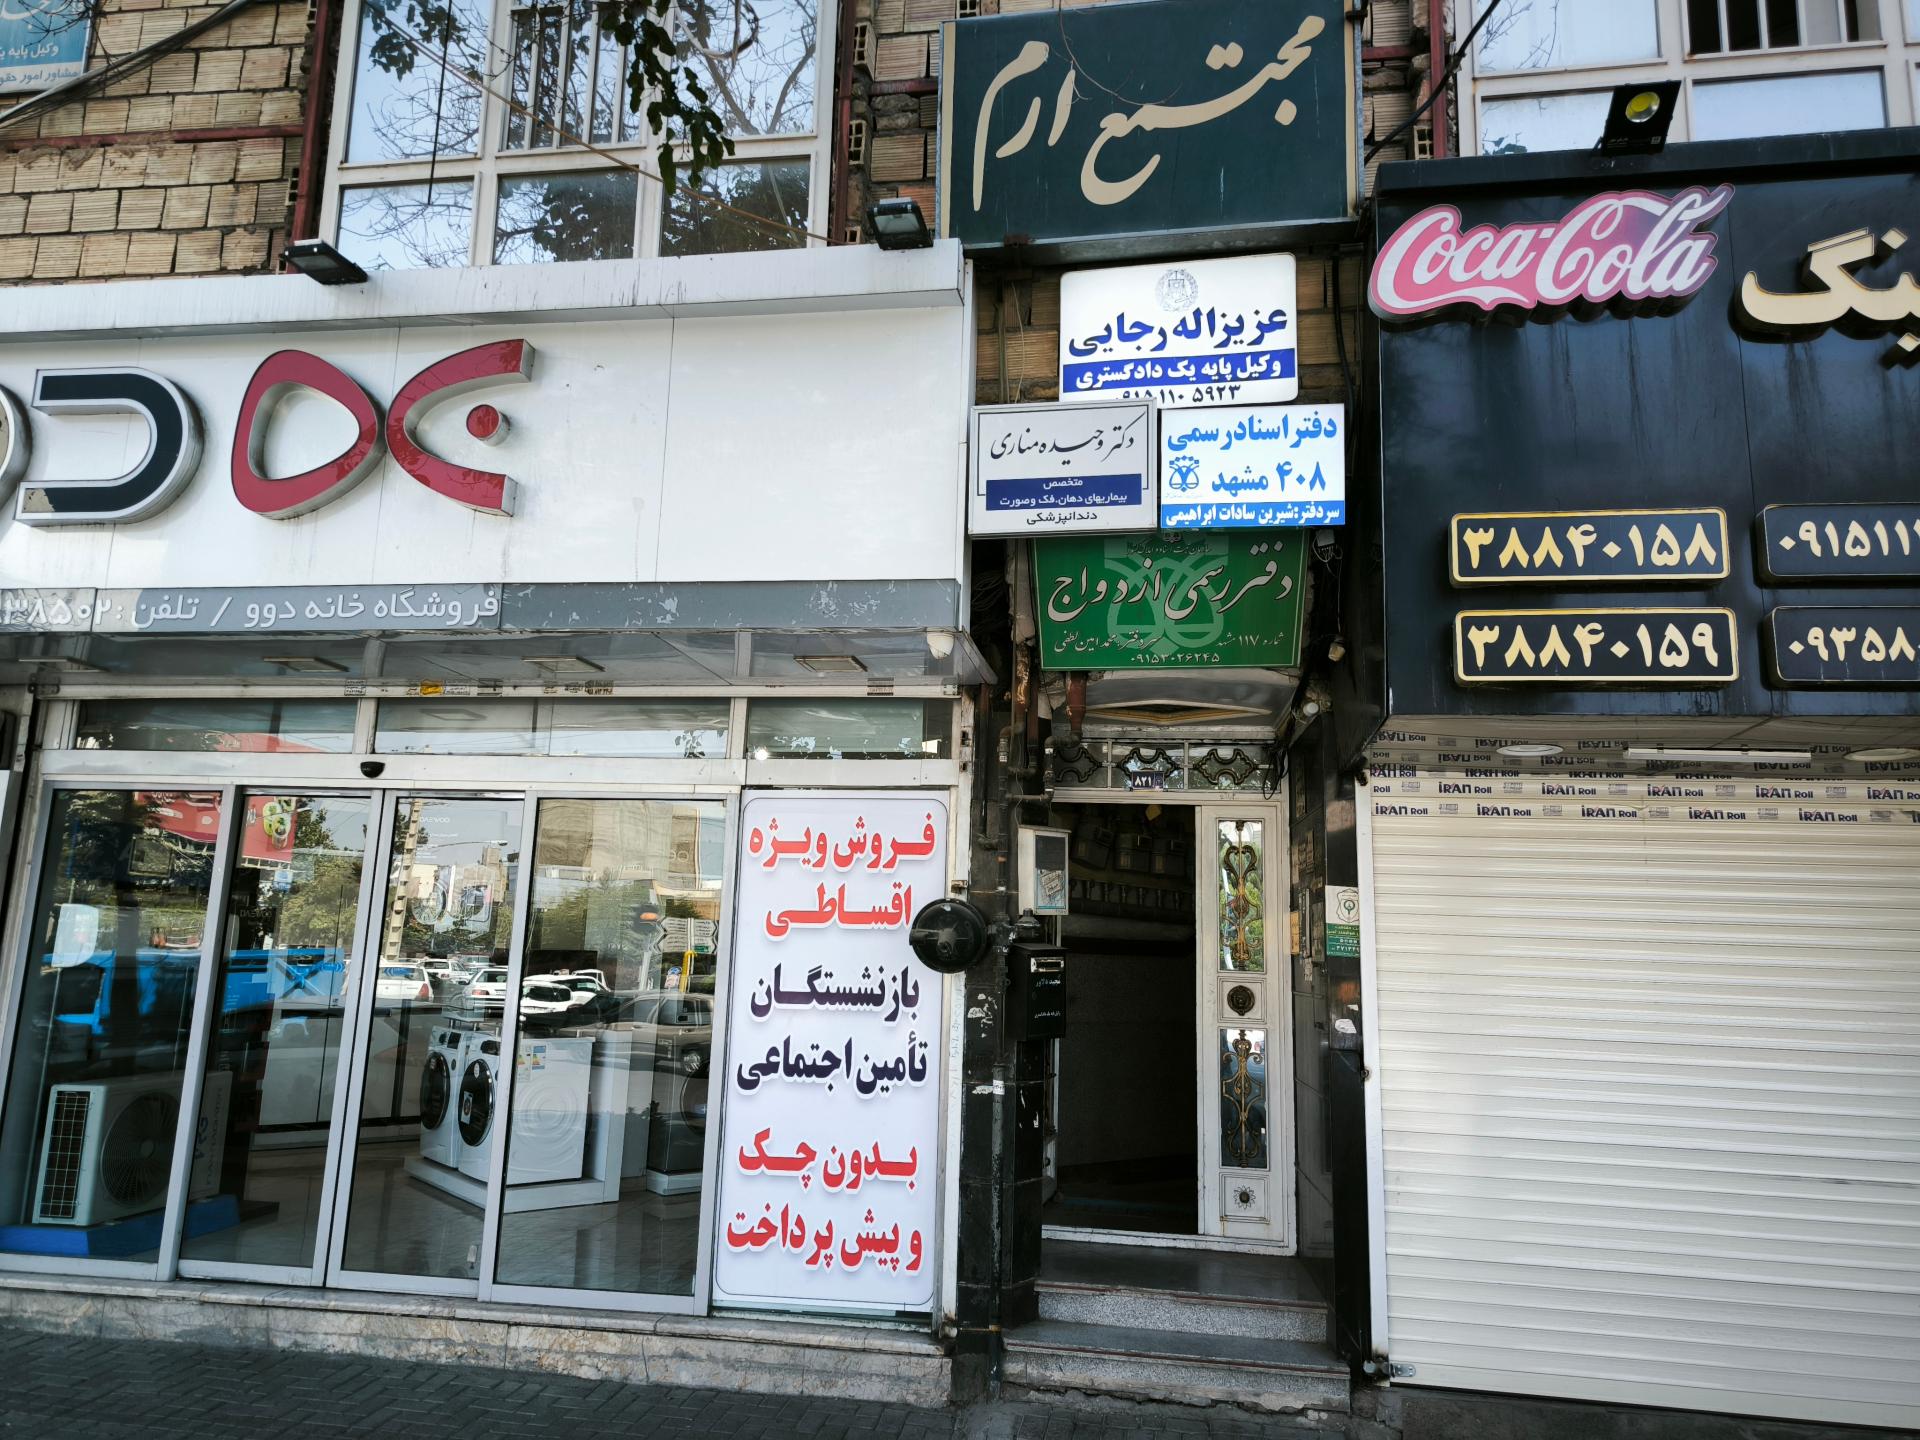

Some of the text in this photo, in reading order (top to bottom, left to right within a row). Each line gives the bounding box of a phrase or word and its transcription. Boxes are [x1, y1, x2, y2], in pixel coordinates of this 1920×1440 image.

[973, 16, 1325, 211] مجتمع ارم
[1376, 192, 1726, 309] Coca-Cola
[1069, 312, 1168, 358] رجایی
[1076, 355, 1281, 390] وکیل پایه یک دادگستری
[1101, 411, 1146, 462] دکتر
[1167, 411, 1337, 452] دفتر اسناد رسمی
[1043, 479, 1083, 490] متخصص
[1211, 461, 1326, 497] ۴۰۸ مشهد
[1026, 511, 1098, 525] دندانپزشکی
[1166, 504, 1216, 527] ابراهیمی
[1219, 503, 1255, 520] سادات
[1463, 523, 1717, 570] ۳۸۸۴۰۱۵۸
[1779, 519, 1920, 558] ۰۹۱۵۱۱
[1047, 540, 1293, 622] دفتر رسمی ازدواج
[243, 603, 296, 628] دوو
[304, 590, 365, 619] خانه
[372, 587, 499, 626] فروشگاه
[1239, 634, 1259, 646] ۱۱۷
[1467, 622, 1719, 669] ۳۸۸۴۰۱۵۹
[1788, 626, 1920, 663] ۰۹۳۵۸
[1373, 785, 1391, 794] Roll
[1474, 786, 1492, 795] Roll
[1578, 787, 1597, 796] Roll
[1684, 788, 1704, 797] Roll
[1794, 790, 1813, 799] Roll
[1410, 807, 1428, 815] Roll
[1513, 808, 1531, 817] Roll
[1618, 809, 1637, 818] Roll
[1726, 811, 1746, 820] Roll
[1837, 814, 1858, 822] Roll
[749, 813, 936, 868] فروش ویژه
[765, 883, 912, 936] اقساطی
[750, 962, 920, 1022] بازنشستگان
[737, 1035, 852, 1094] اجتماعی
[739, 1128, 917, 1191] بدون چک
[727, 1204, 922, 1271] و پیش پرداخت
